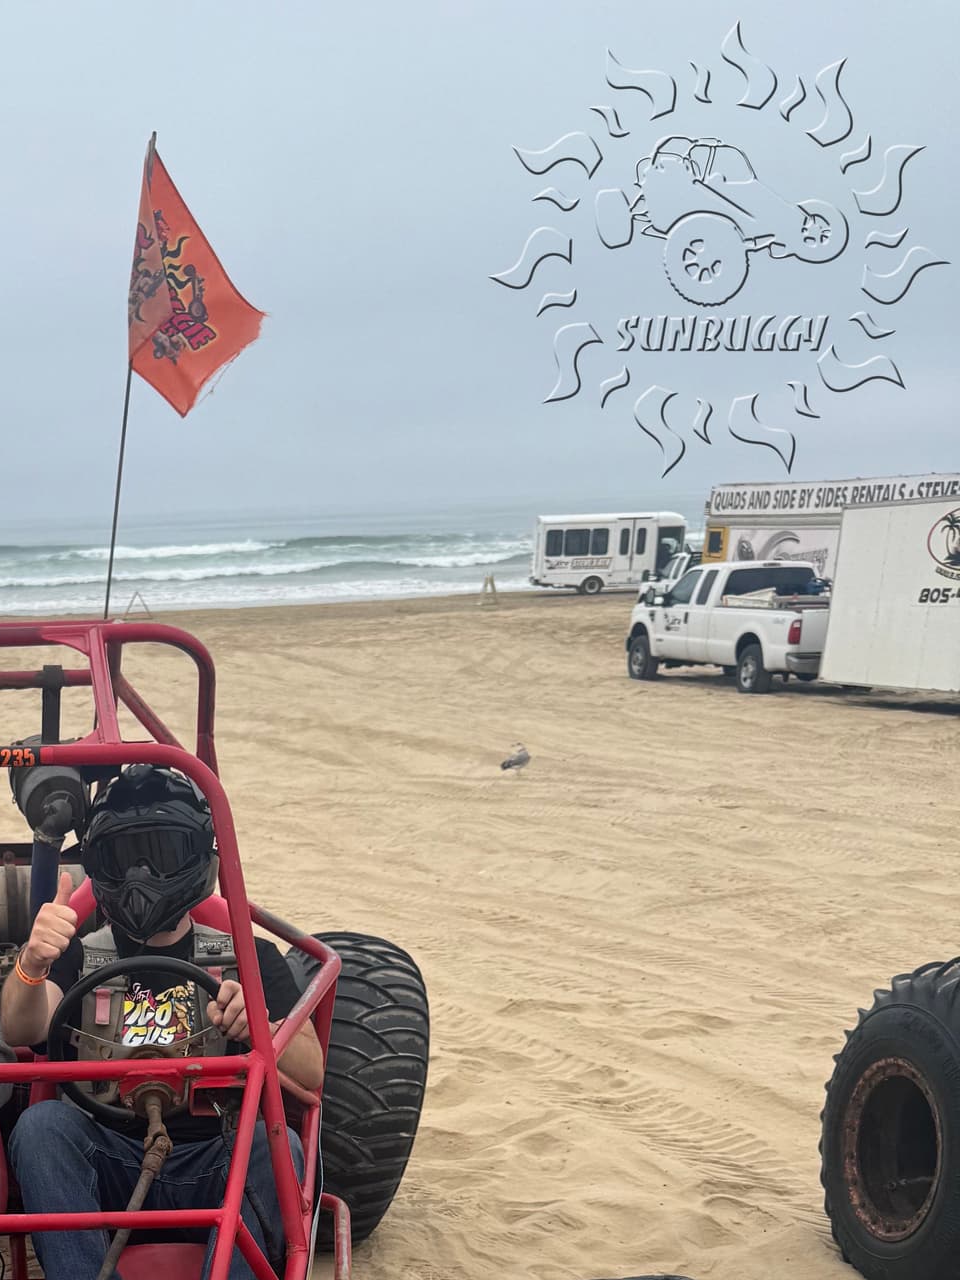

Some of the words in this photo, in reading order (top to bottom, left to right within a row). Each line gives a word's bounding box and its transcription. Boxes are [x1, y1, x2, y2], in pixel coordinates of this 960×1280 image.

[714, 491, 747, 511] QUADS
[747, 490, 771, 510] AND
[772, 489, 797, 509] SIDE
[798, 488, 814, 508] BY
[814, 486, 848, 508] SIDES
[917, 481, 960, 499] STEVE
